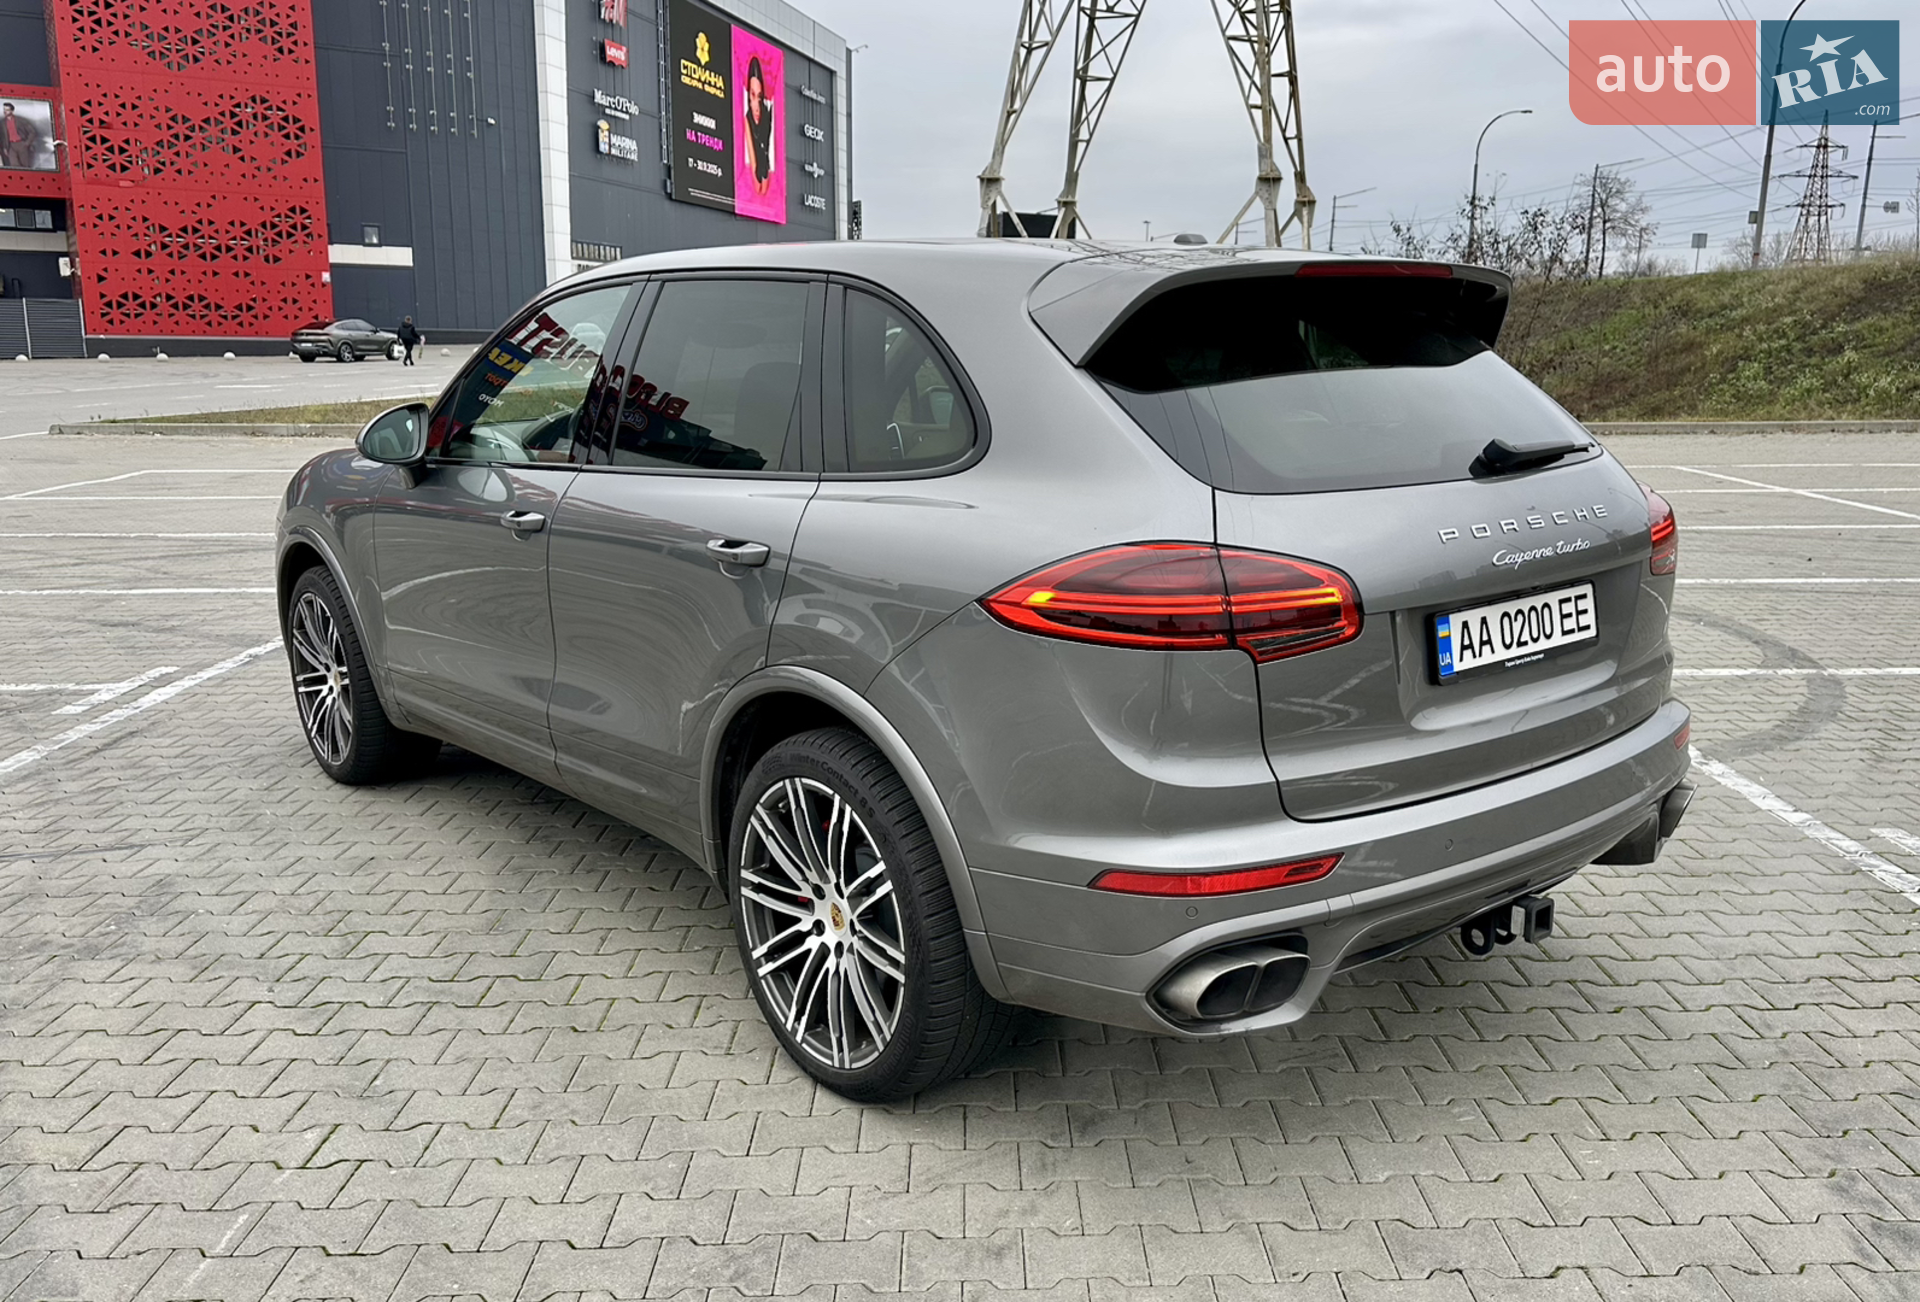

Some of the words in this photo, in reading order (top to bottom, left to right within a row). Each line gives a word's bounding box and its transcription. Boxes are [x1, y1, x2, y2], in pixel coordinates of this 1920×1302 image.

[803, 124, 825, 142] GEOX
[610, 134, 638, 151] MARINA
[610, 147, 638, 162] MILITARE
[804, 194, 826, 211] LACOSTE
[1437, 504, 1609, 544] PORSCHE
[1492, 545, 1554, 570] Cayenne
[1556, 538, 1591, 555] turbo
[1458, 615, 1496, 663] AA
[1499, 601, 1554, 651] 0200
[1557, 592, 1592, 637] EE
[1438, 652, 1452, 667] UA
